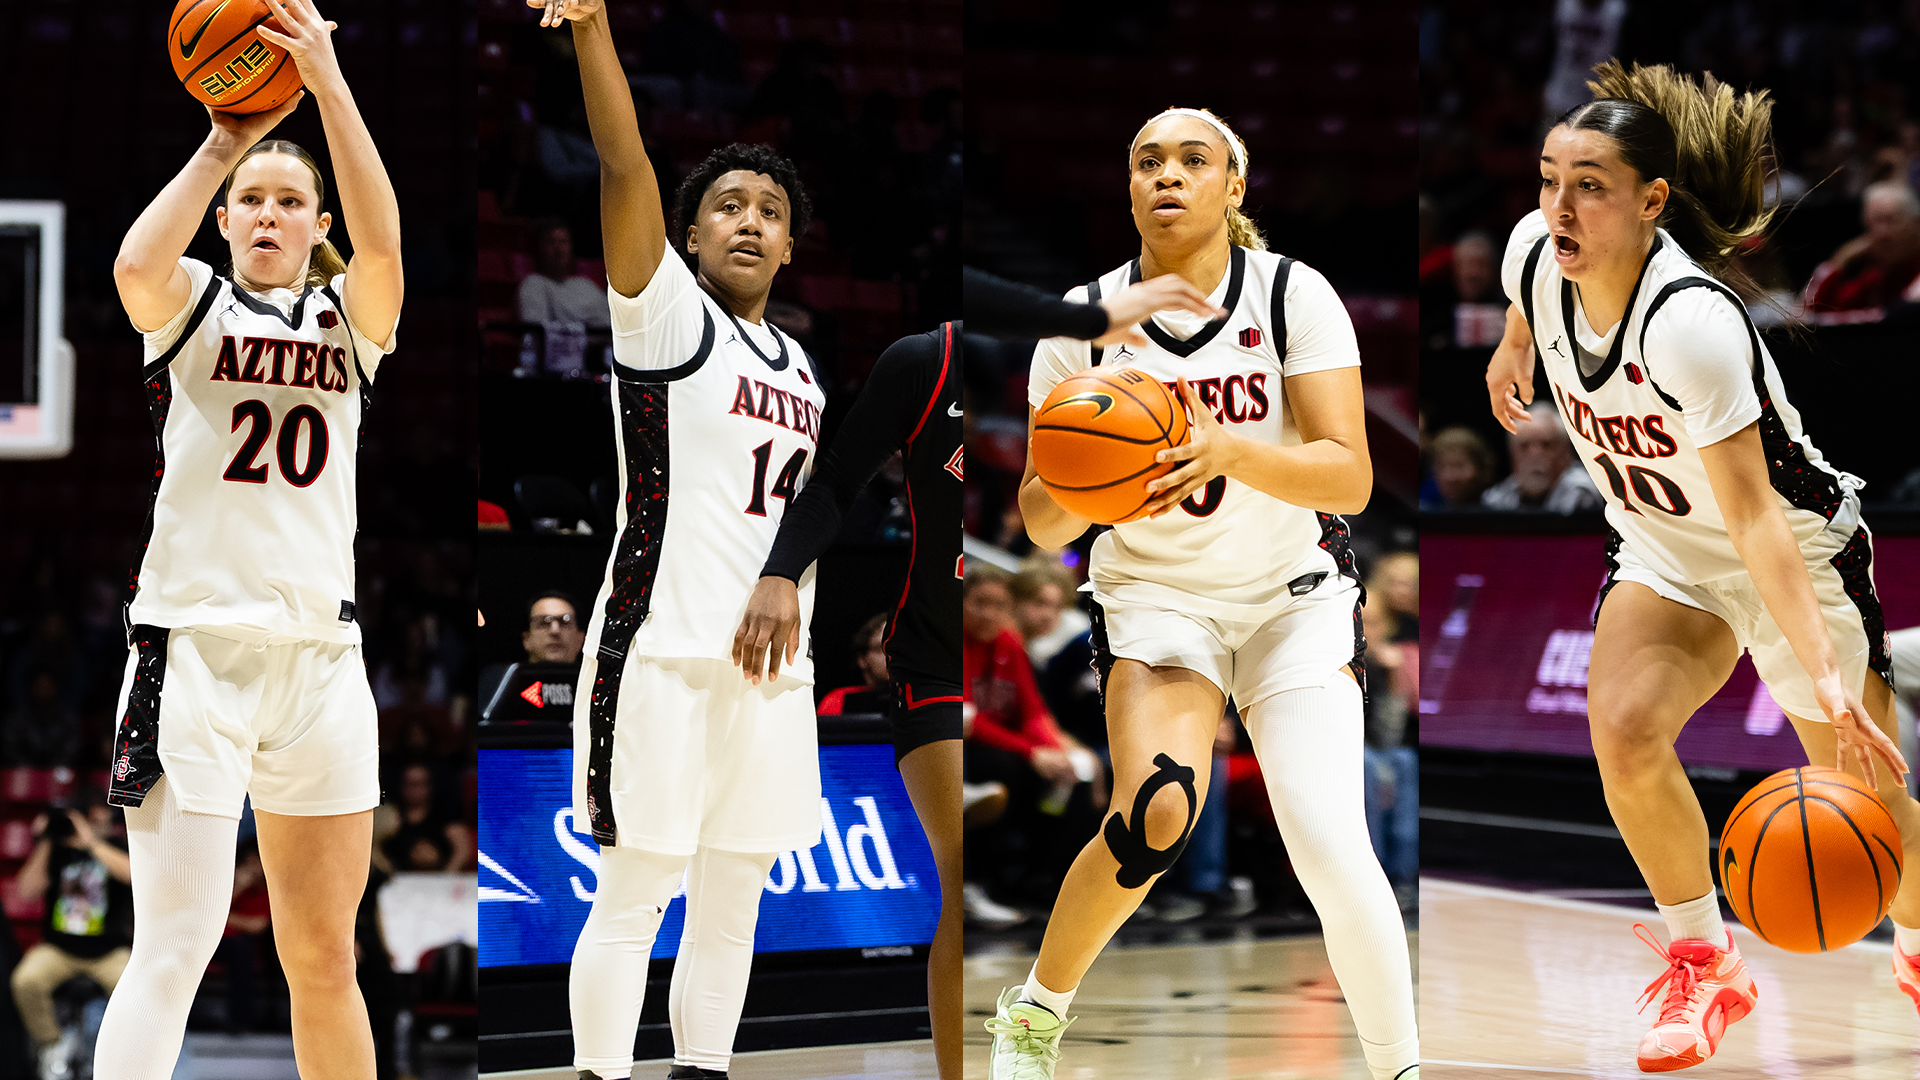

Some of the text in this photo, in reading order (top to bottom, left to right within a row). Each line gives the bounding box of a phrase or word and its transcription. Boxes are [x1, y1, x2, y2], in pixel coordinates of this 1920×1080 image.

[198, 38, 272, 98] ELITE
[215, 54, 276, 102] CHAMPIONSHIP
[209, 335, 349, 394] AZTECS
[1162, 372, 1270, 428] ECS
[222, 398, 330, 489] 20
[744, 437, 809, 525] 14
[1593, 451, 1693, 519] 10
[553, 795, 907, 902] Sorld
